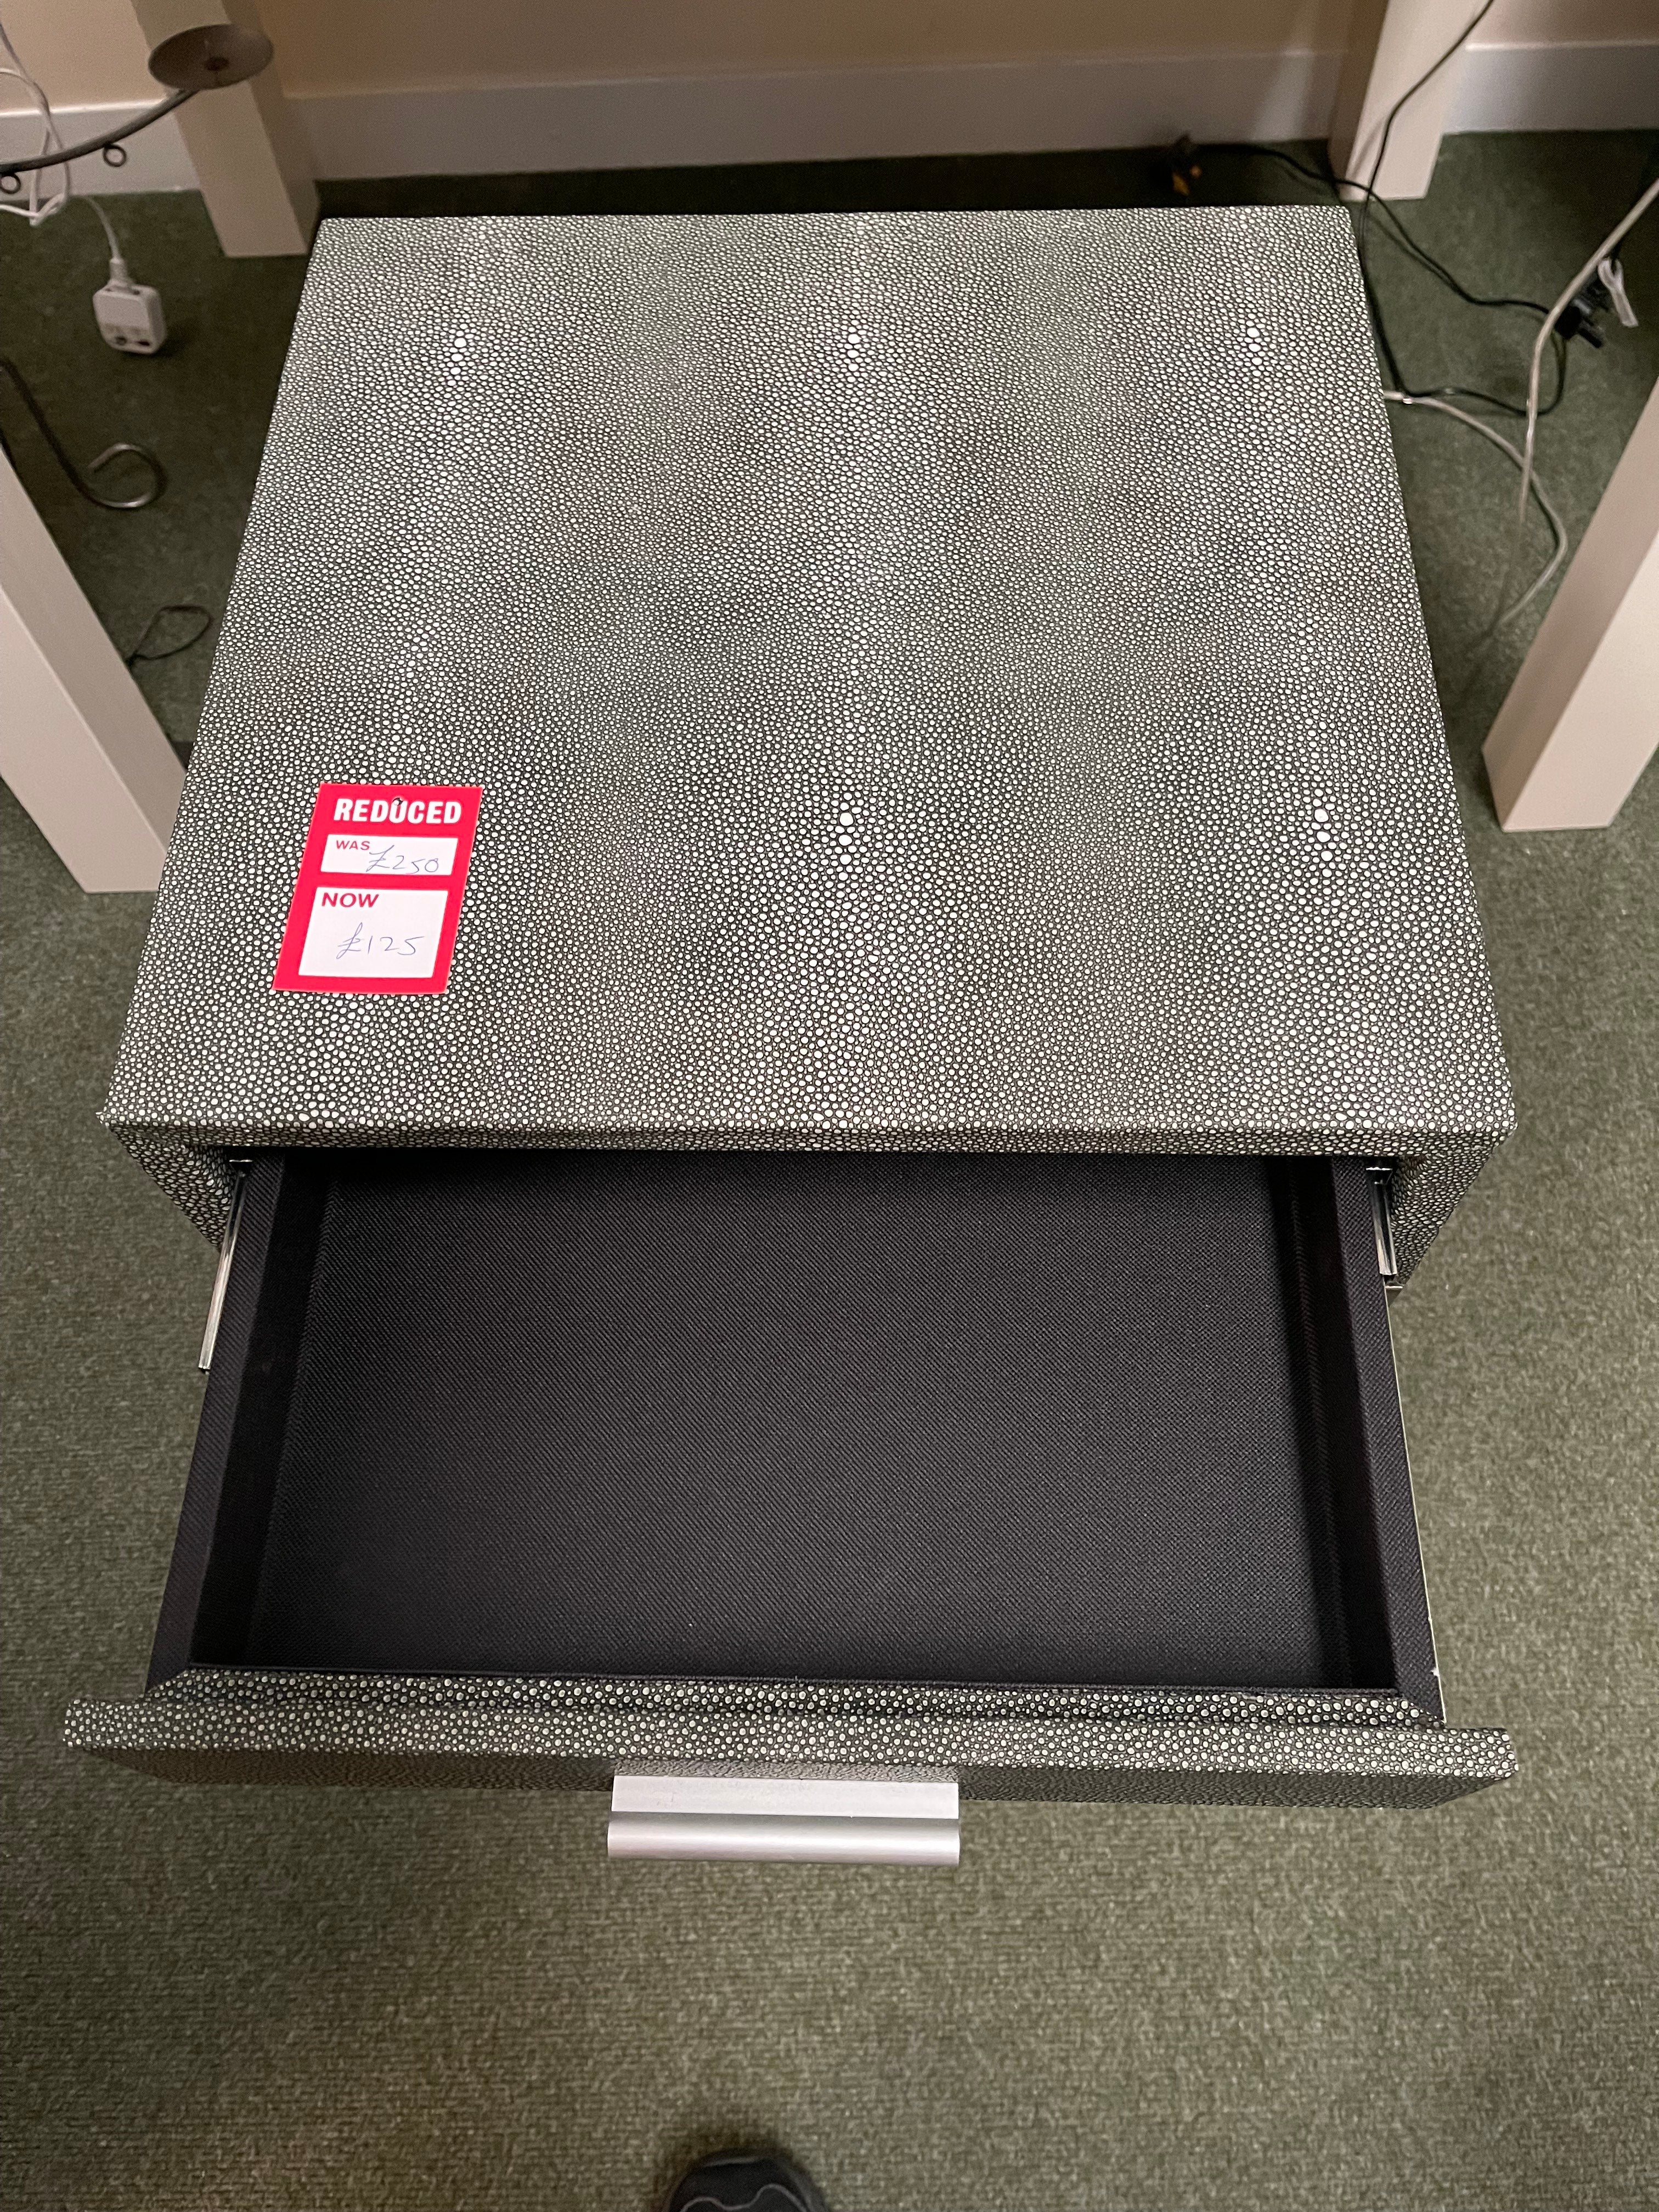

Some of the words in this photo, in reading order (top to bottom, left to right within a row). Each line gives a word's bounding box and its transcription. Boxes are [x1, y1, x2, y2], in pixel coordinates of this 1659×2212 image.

[333, 798, 462, 823] REDUCED
[336, 840, 370, 850] WAS
[366, 845, 438, 874] £250
[321, 892, 379, 907] NOW
[336, 922, 425, 959] £125
